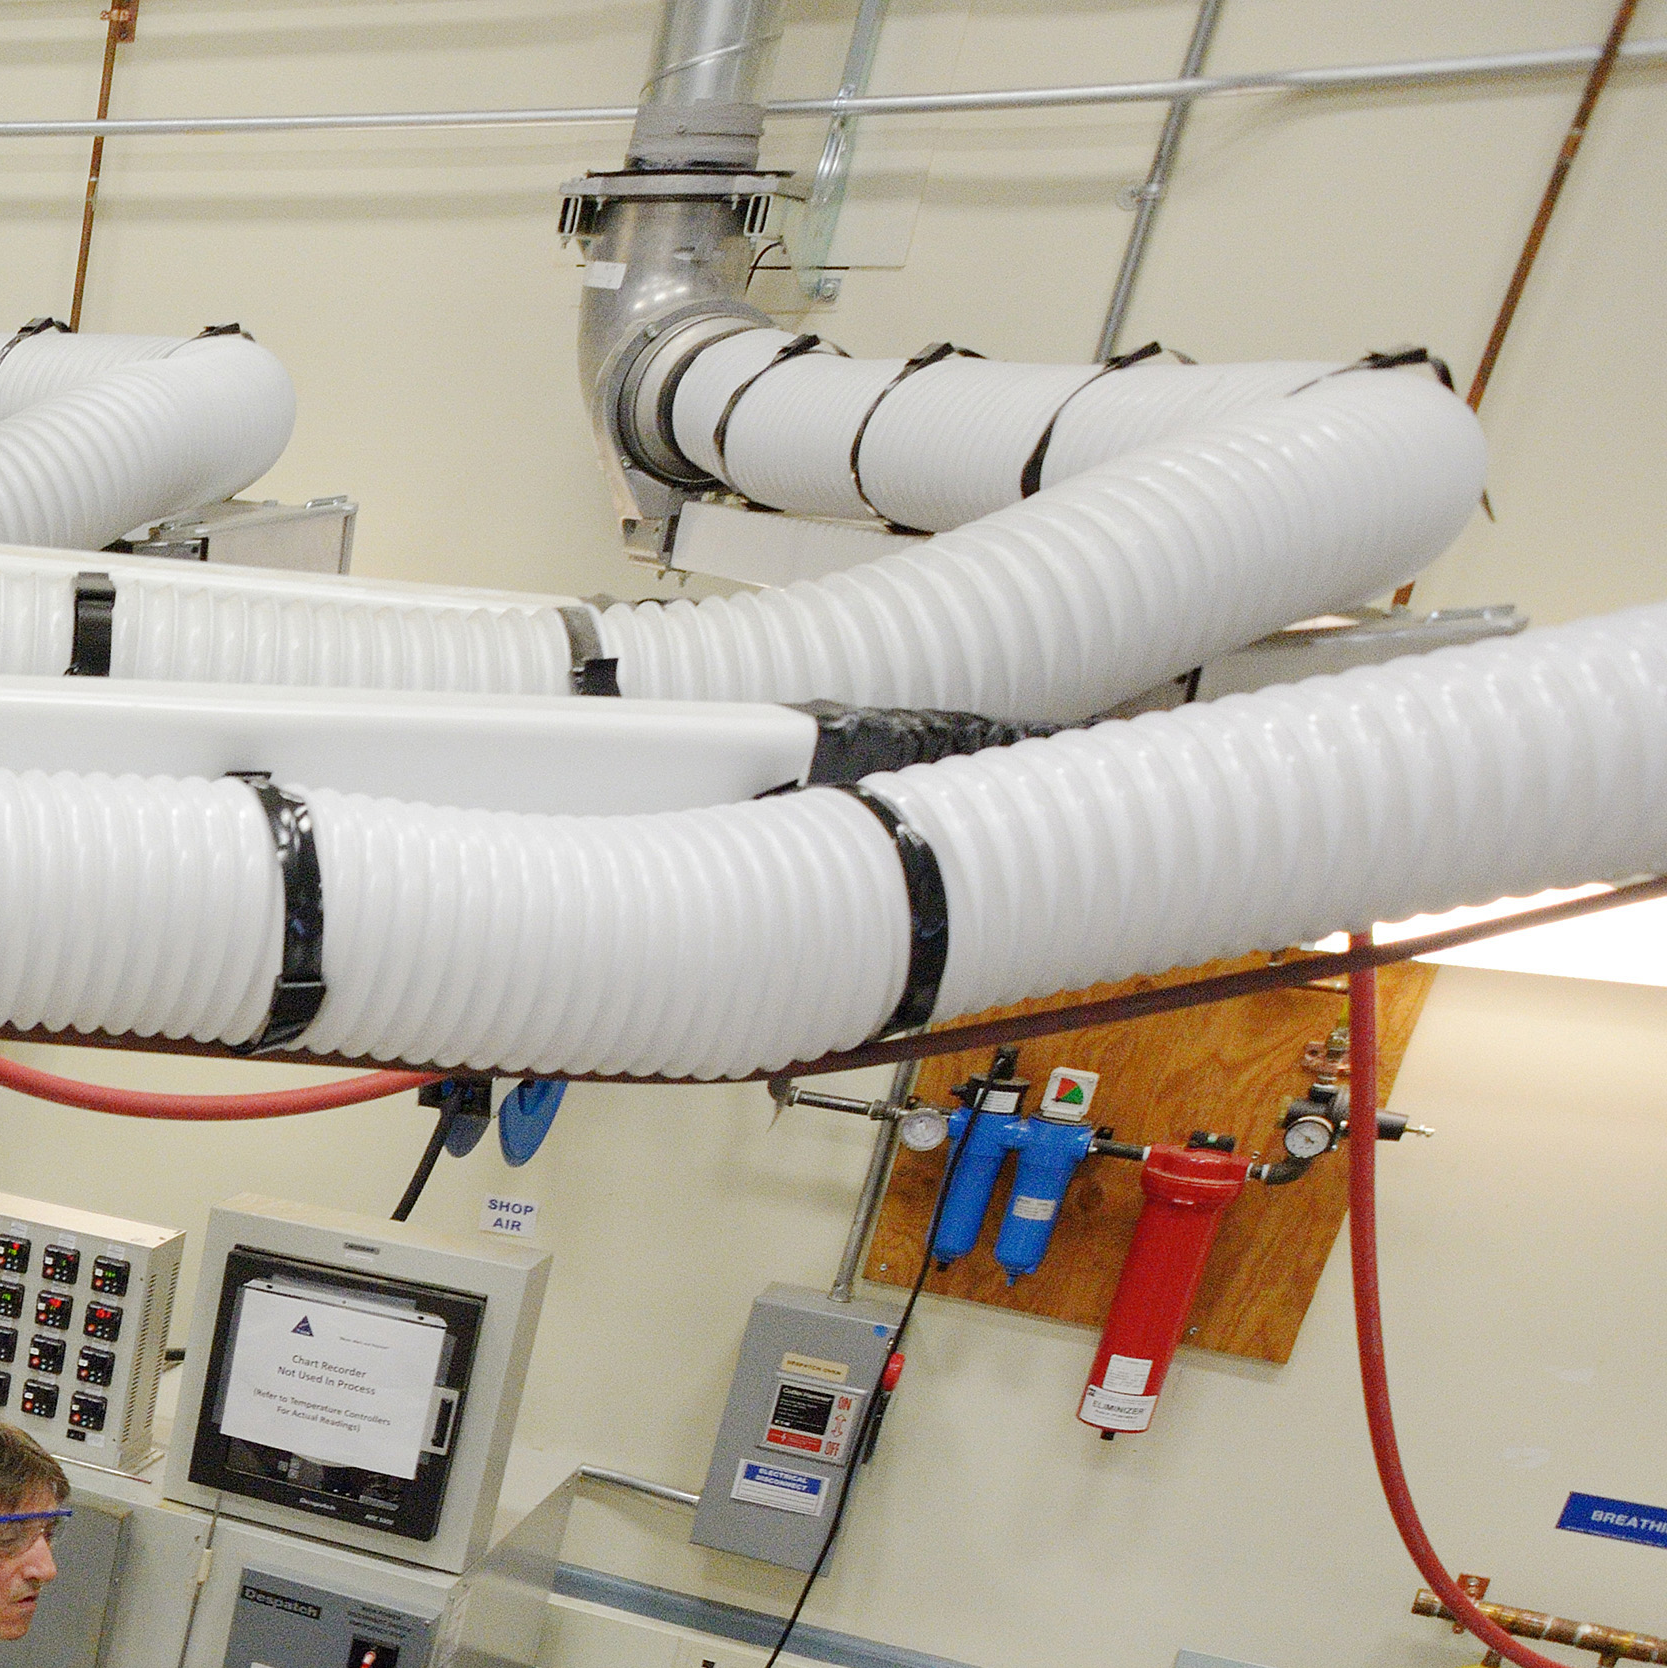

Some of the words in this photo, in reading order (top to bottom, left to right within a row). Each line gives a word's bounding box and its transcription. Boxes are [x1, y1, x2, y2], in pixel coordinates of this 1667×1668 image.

[488, 1198, 534, 1215] SHOP
[493, 1217, 522, 1231] AIR
[291, 1354, 319, 1370] Chart
[320, 1359, 367, 1379] Recorder
[277, 1365, 297, 1379] Not
[297, 1369, 323, 1385] Used
[324, 1376, 335, 1387] In
[336, 1379, 376, 1397] Process
[252, 1386, 279, 1402] (Refer
[278, 1393, 288, 1404] to
[289, 1395, 343, 1417] Temperature
[343, 1406, 392, 1426] Controllers
[837, 1395, 853, 1411] ON
[1092, 1400, 1145, 1415] ELIMINIZER
[276, 1404, 291, 1417] For
[290, 1408, 319, 1424] Actual
[318, 1413, 362, 1433] Readings)
[824, 1440, 840, 1457] OFF
[754, 1473, 809, 1491] DISCONNECT
[758, 1466, 808, 1484] ELECTRICAL
[1590, 1509, 1667, 1535] BREATHI
[243, 1586, 319, 1619] Despatch
